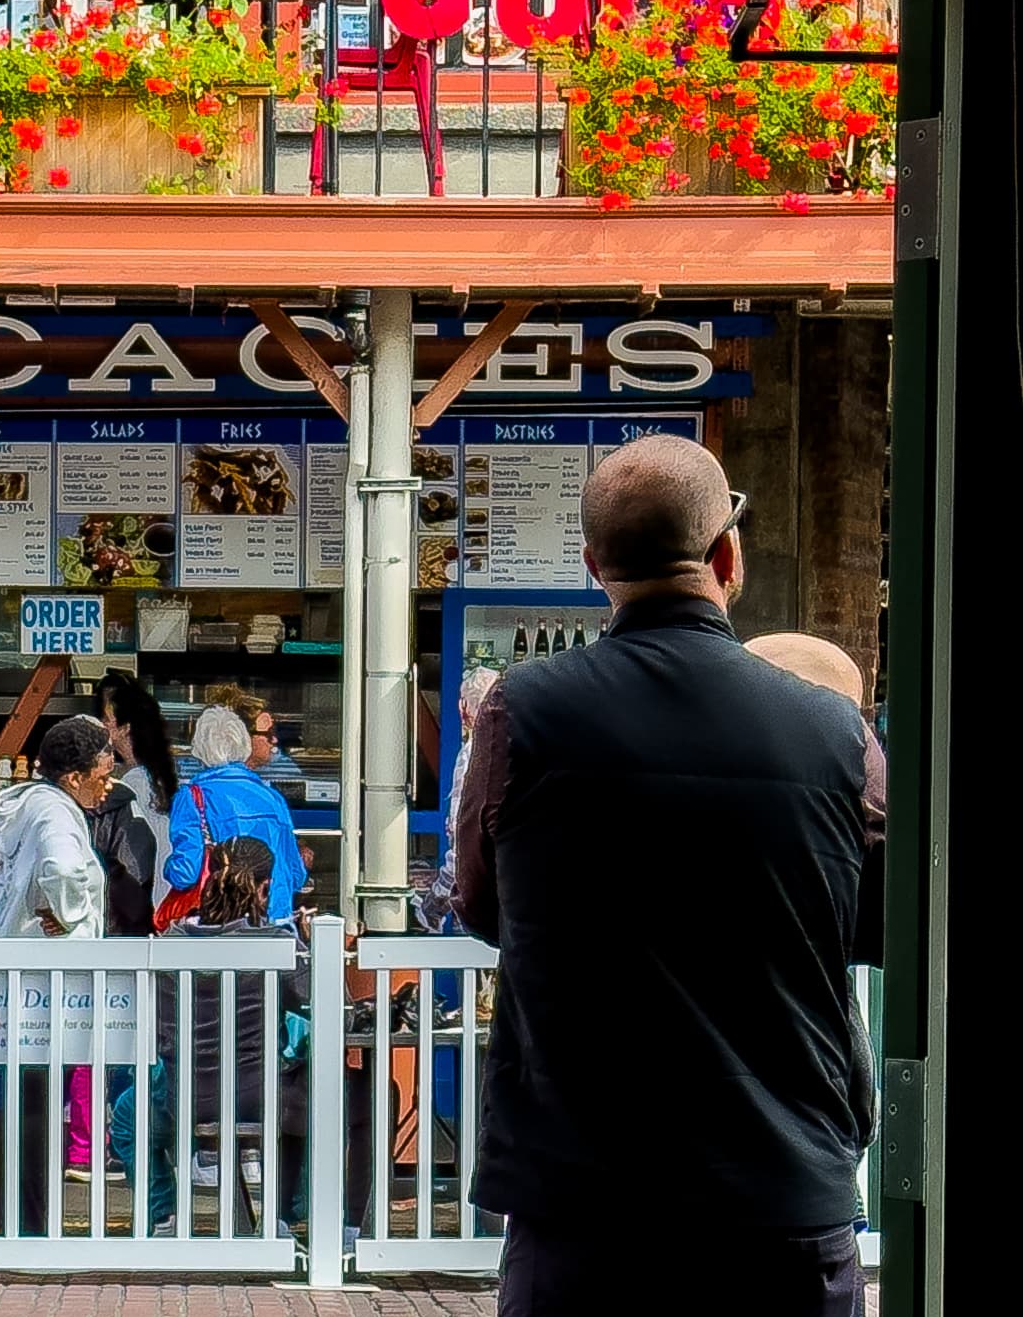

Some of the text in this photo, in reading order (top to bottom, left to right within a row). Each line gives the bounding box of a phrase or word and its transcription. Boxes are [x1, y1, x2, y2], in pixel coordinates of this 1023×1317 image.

[90, 421, 145, 439] SALADS
[221, 422, 262, 439] FRIES
[495, 423, 555, 441] PASTRIES
[22, 599, 101, 628] ORDER
[32, 631, 93, 653] HERE
[23, 988, 131, 1010] Deicaies
